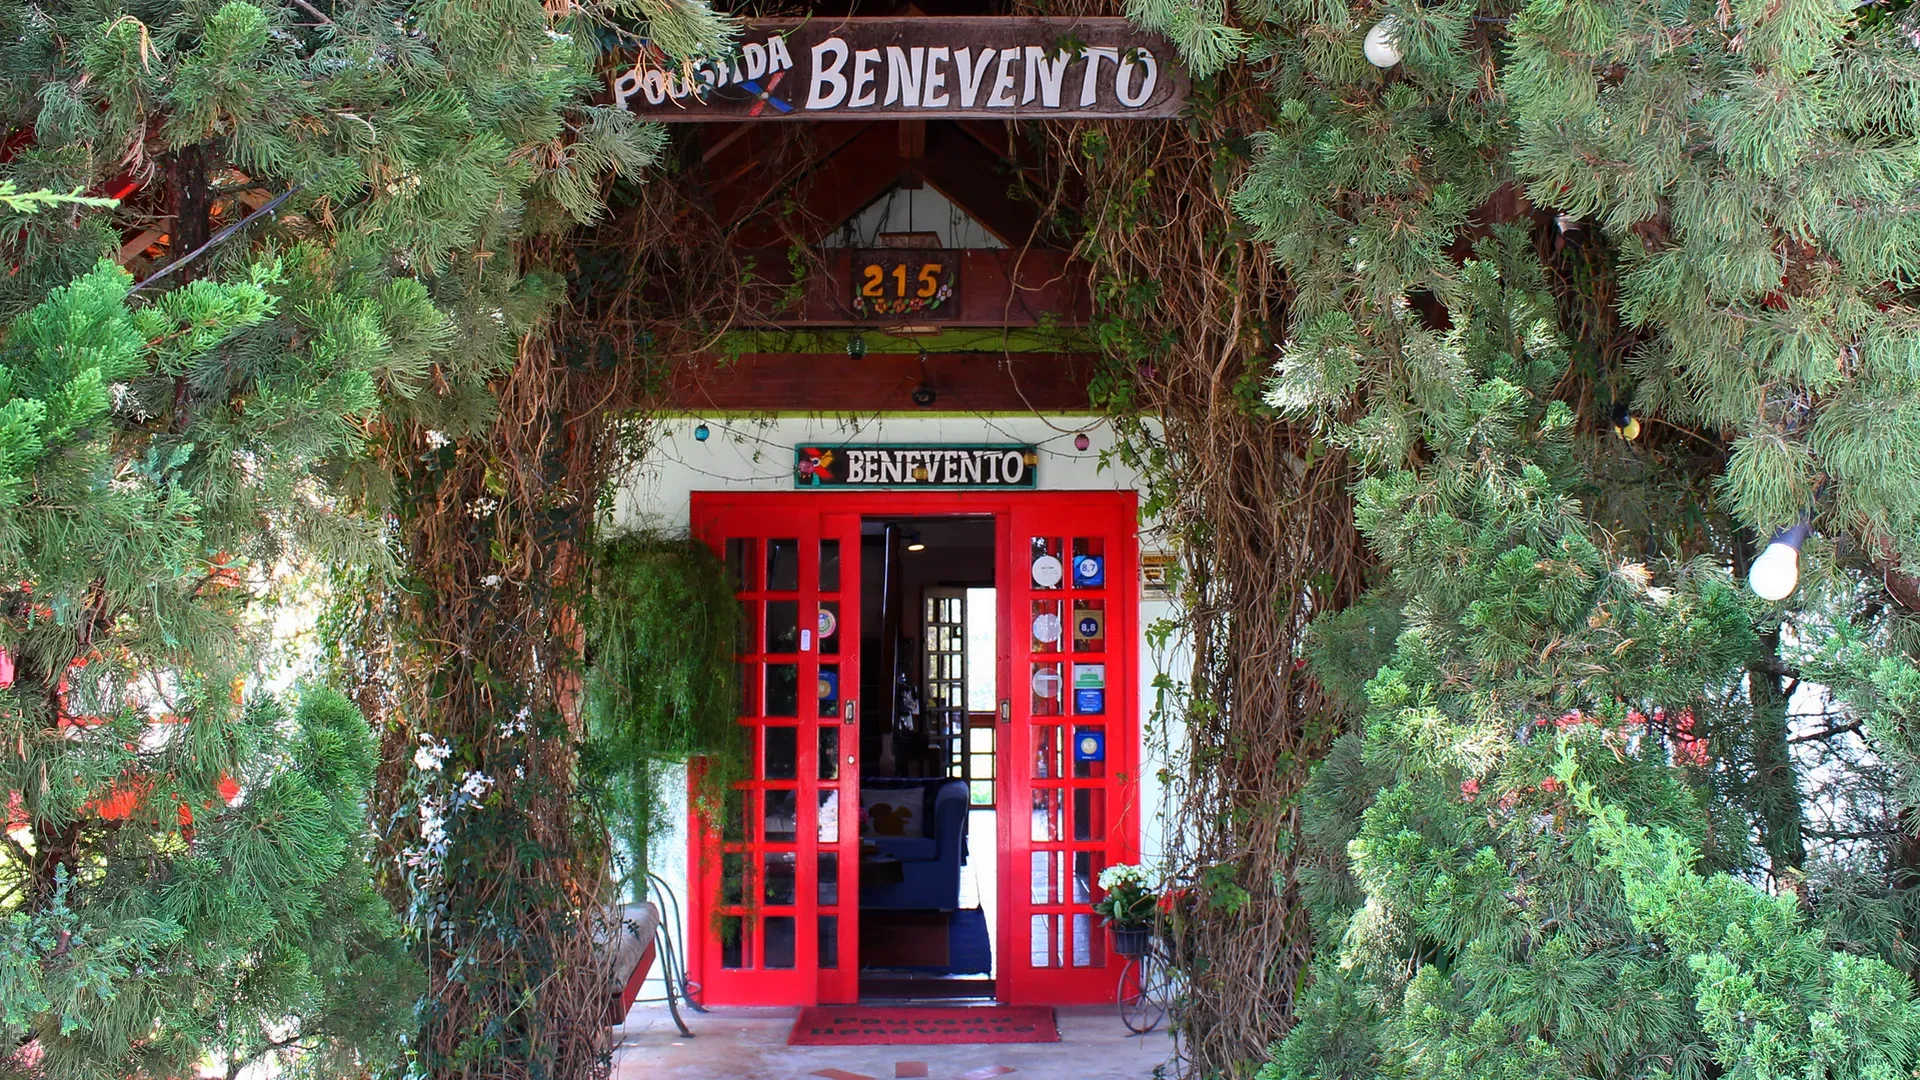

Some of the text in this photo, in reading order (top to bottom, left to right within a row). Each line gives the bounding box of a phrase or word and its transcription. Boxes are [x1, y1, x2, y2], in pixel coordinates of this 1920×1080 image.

[805, 37, 1157, 109] BENEVENTO
[862, 263, 942, 298] 215
[846, 450, 1024, 484] BENEVENTO
[1081, 563, 1096, 573] 8,7
[1081, 623, 1096, 633] 8,8
